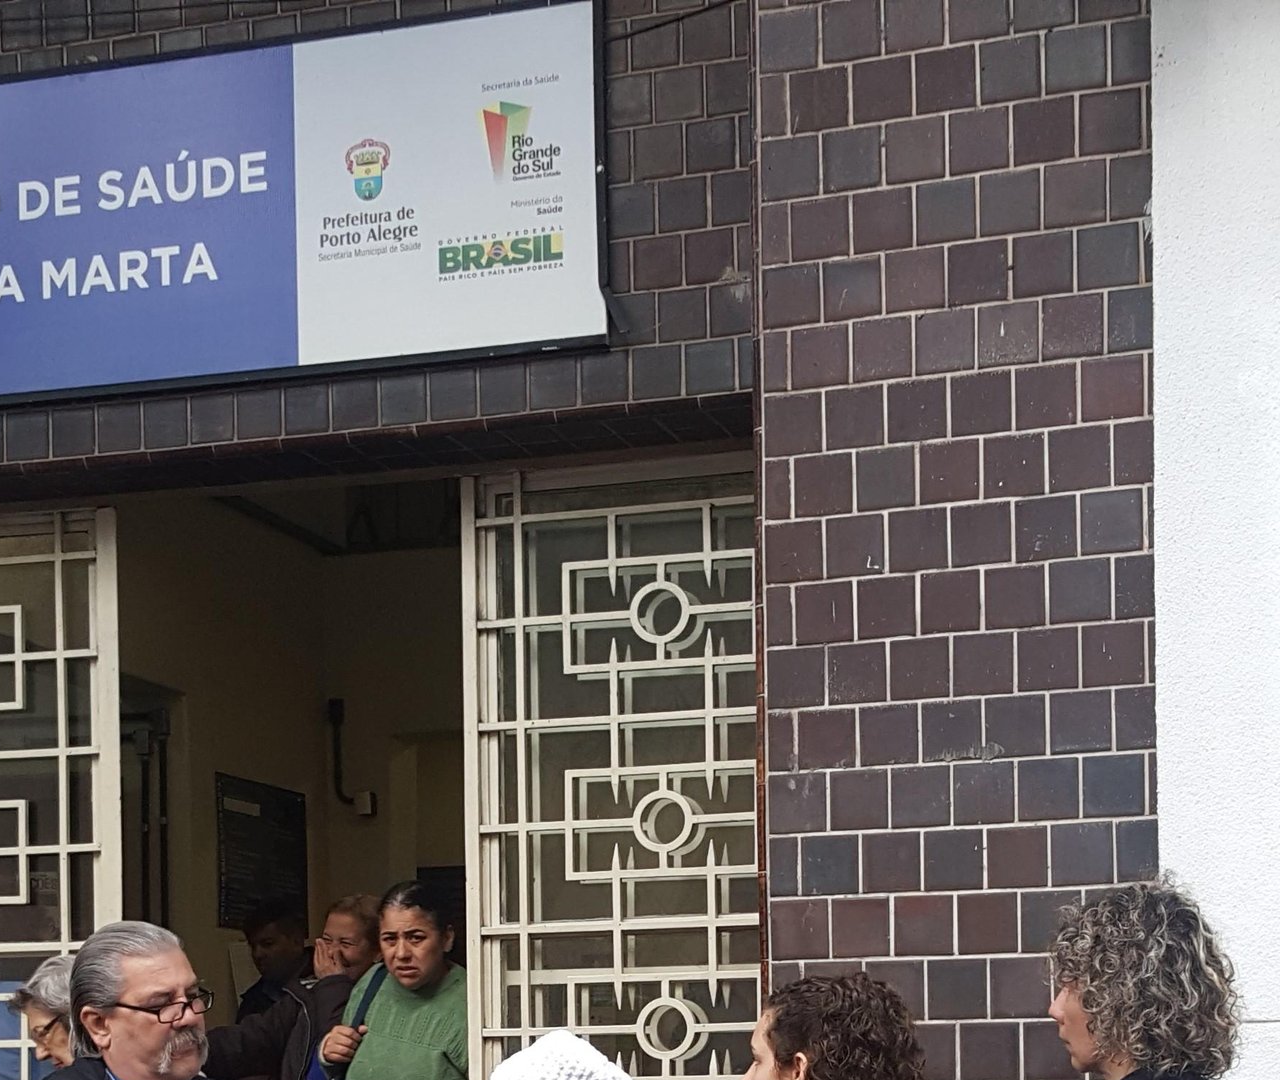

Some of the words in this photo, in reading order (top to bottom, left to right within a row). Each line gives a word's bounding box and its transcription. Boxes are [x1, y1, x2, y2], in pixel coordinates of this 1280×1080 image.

[481, 79, 520, 92] Secretaria
[522, 77, 533, 86] da
[534, 73, 560, 85] Saúde
[512, 133, 534, 149] Rio
[512, 143, 561, 162] Grande
[512, 161, 530, 175] do
[532, 157, 553, 172] Sul
[18, 174, 81, 221] DE
[97, 149, 268, 211] SAÚDE
[510, 196, 551, 208] Ministério
[552, 194, 563, 204] da
[536, 205, 563, 216] Saúde
[323, 211, 392, 230] Prefeitura
[397, 206, 415, 220] de
[320, 231, 362, 248] Porto
[366, 224, 419, 242] Alegre
[438, 233, 497, 246] GOVERNO
[506, 225, 564, 237] FEDERAL
[318, 248, 353, 262] Secretaria
[354, 246, 388, 257] Municipal
[389, 244, 398, 253] de
[400, 242, 422, 253] Saúde
[438, 233, 564, 275] BRASIL
[41, 241, 219, 300] MARTA
[526, 262, 564, 271] POBREZA
